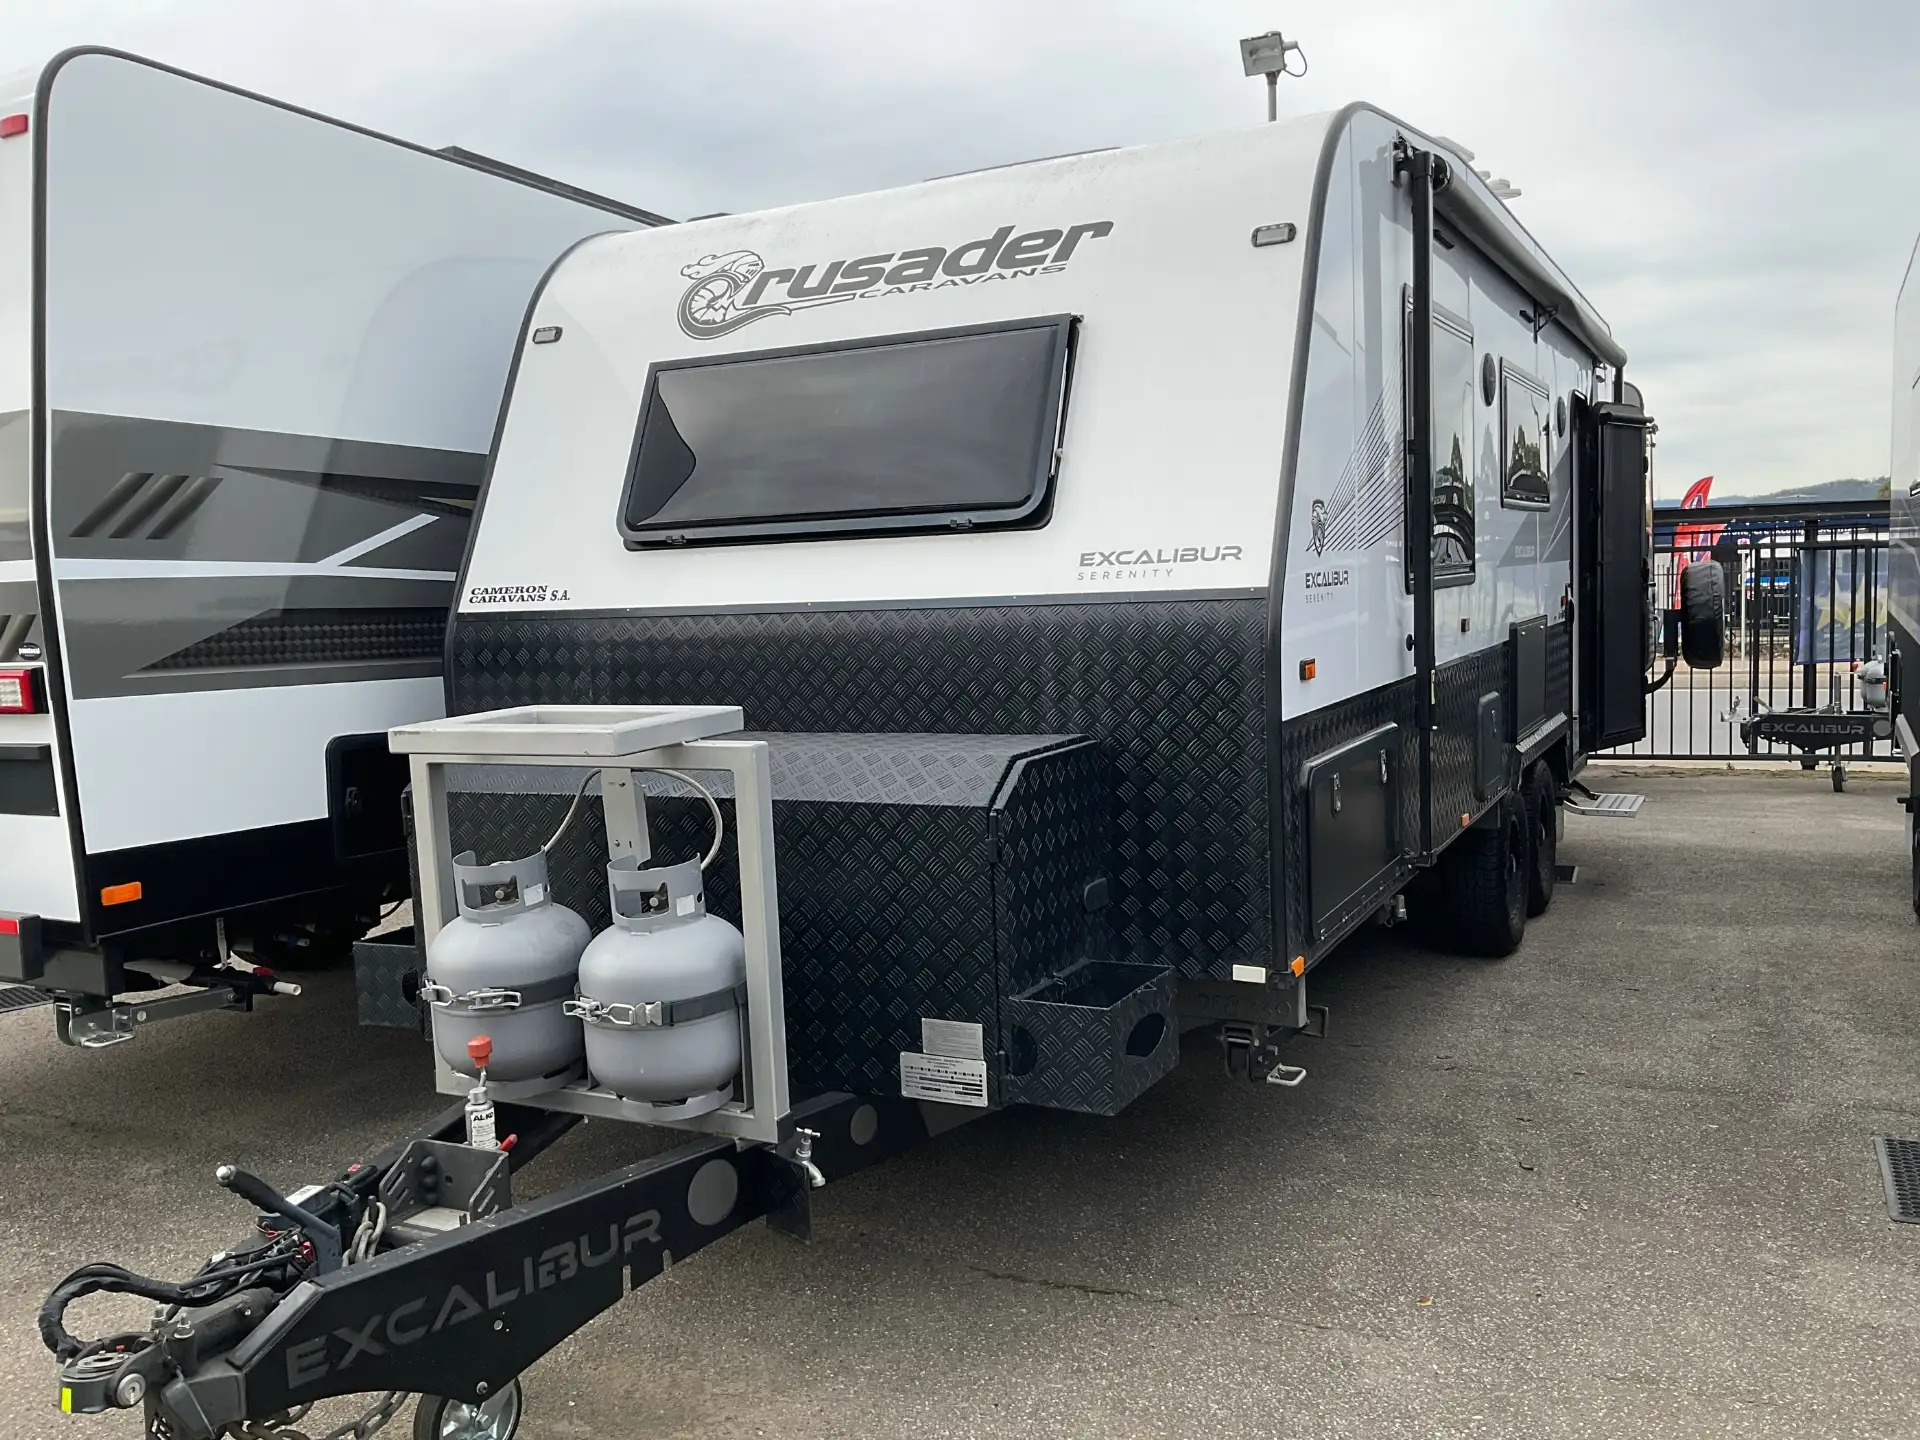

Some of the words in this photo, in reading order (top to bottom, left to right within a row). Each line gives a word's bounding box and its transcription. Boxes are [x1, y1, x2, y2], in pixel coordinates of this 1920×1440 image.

[856, 263, 1068, 299] CARAVANS
[1079, 545, 1243, 567] EXCALIBUR
[1077, 568, 1174, 581] SERENITY
[1305, 569, 1349, 589] EXCALIBUR
[469, 594, 547, 603] CARAVANS
[550, 590, 571, 601] S.A.
[471, 585, 548, 595] CAMERON
[1305, 593, 1334, 604] SERENITY
[1761, 722, 1864, 734] EXCALIBUR
[286, 1208, 663, 1391] EXCALIBUR
